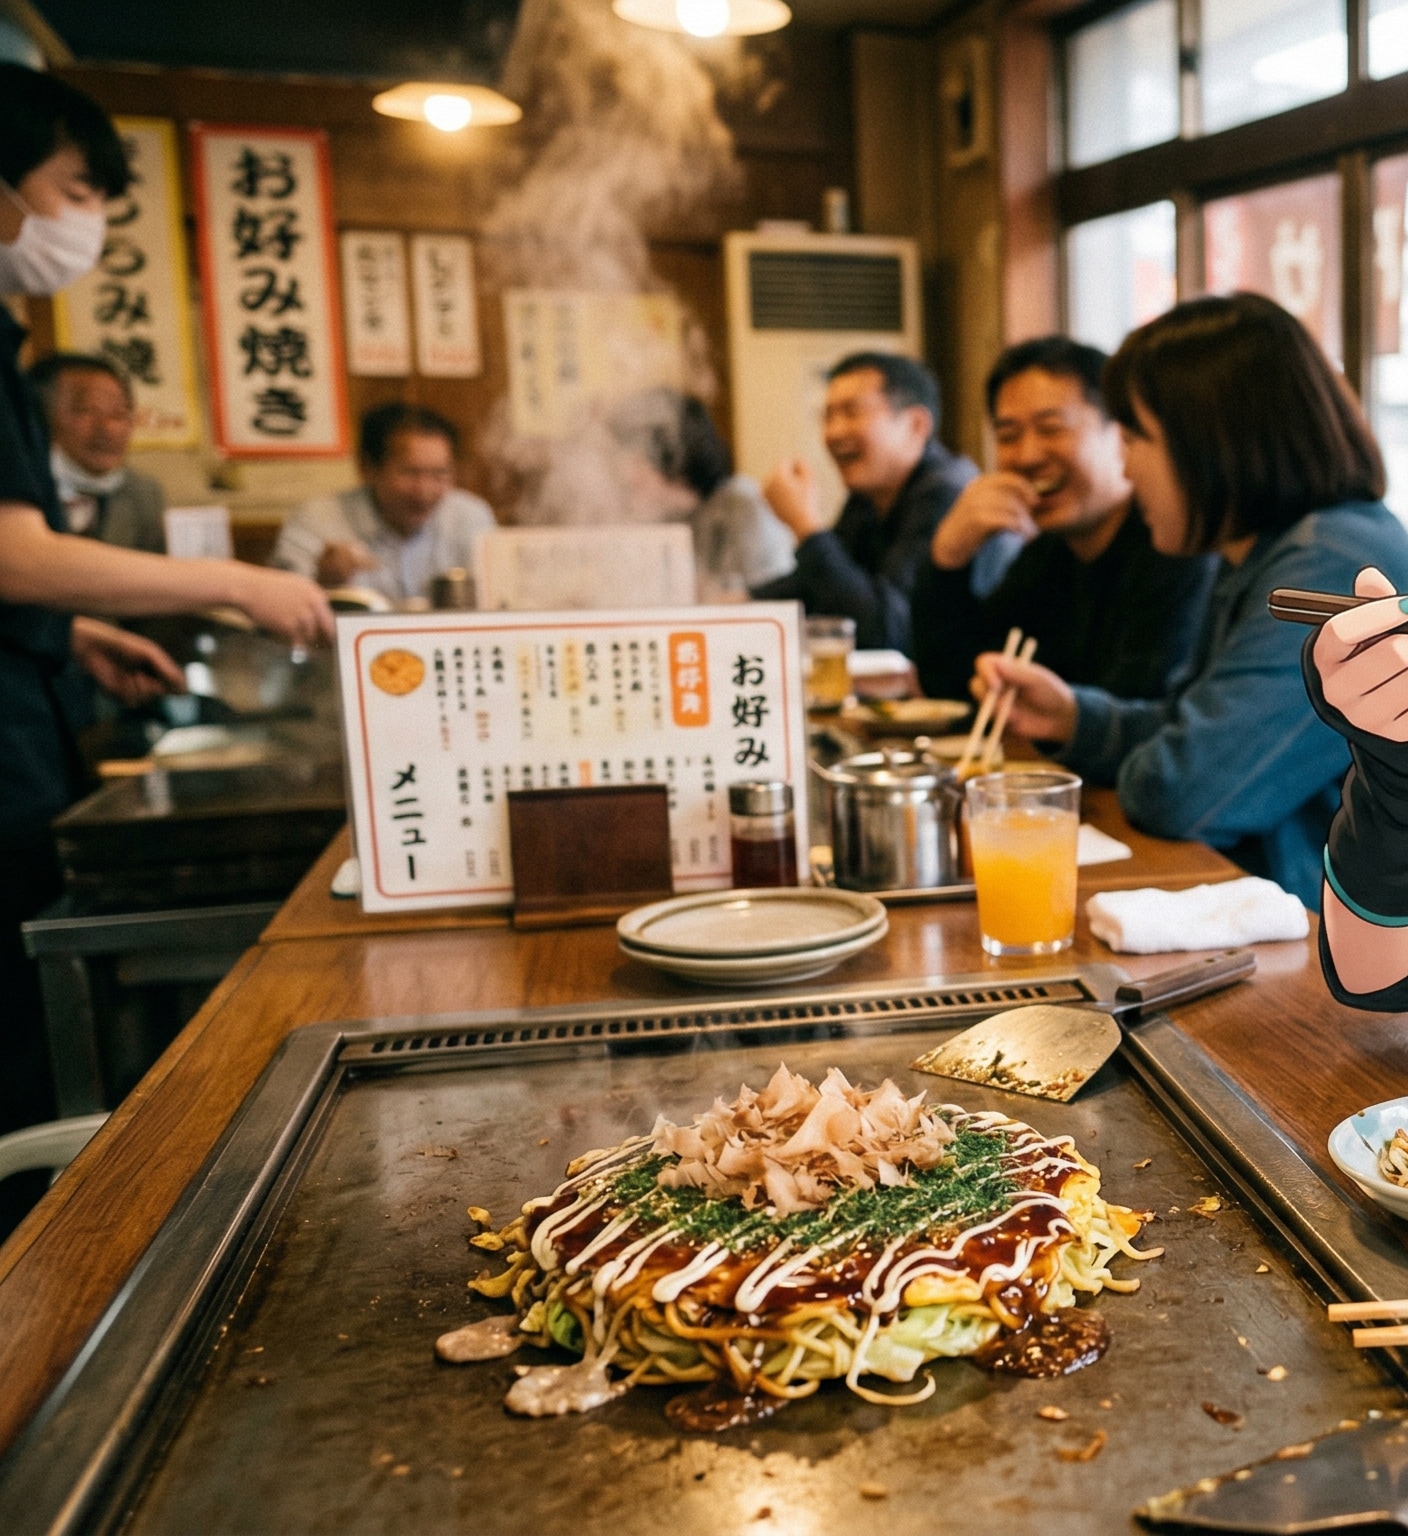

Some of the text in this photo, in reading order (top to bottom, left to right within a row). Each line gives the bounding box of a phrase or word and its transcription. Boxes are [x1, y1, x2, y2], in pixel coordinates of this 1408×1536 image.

[231, 145, 313, 436] お好み焼き
[732, 654, 769, 768] お好み
[392, 764, 426, 881] メニュー
